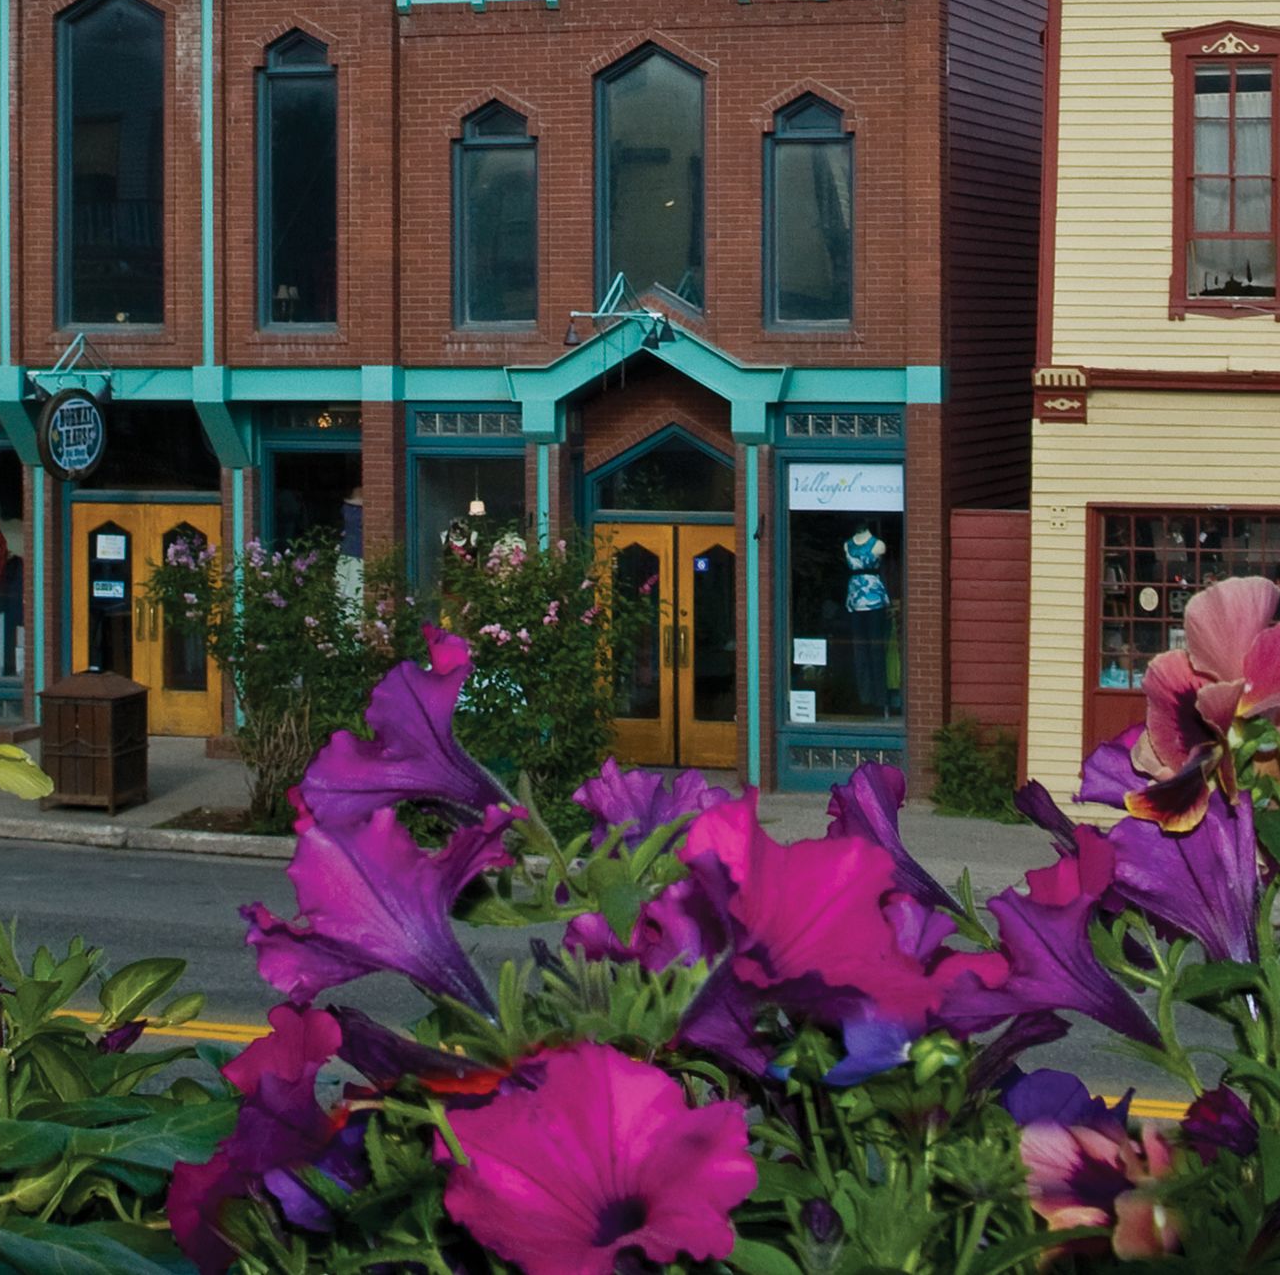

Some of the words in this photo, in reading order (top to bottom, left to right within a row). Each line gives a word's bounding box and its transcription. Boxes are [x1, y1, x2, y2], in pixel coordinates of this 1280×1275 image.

[59, 406, 94, 429] NORWAY
[793, 471, 863, 504] Valleygirl
[861, 485, 903, 494] BOUTIQUE
